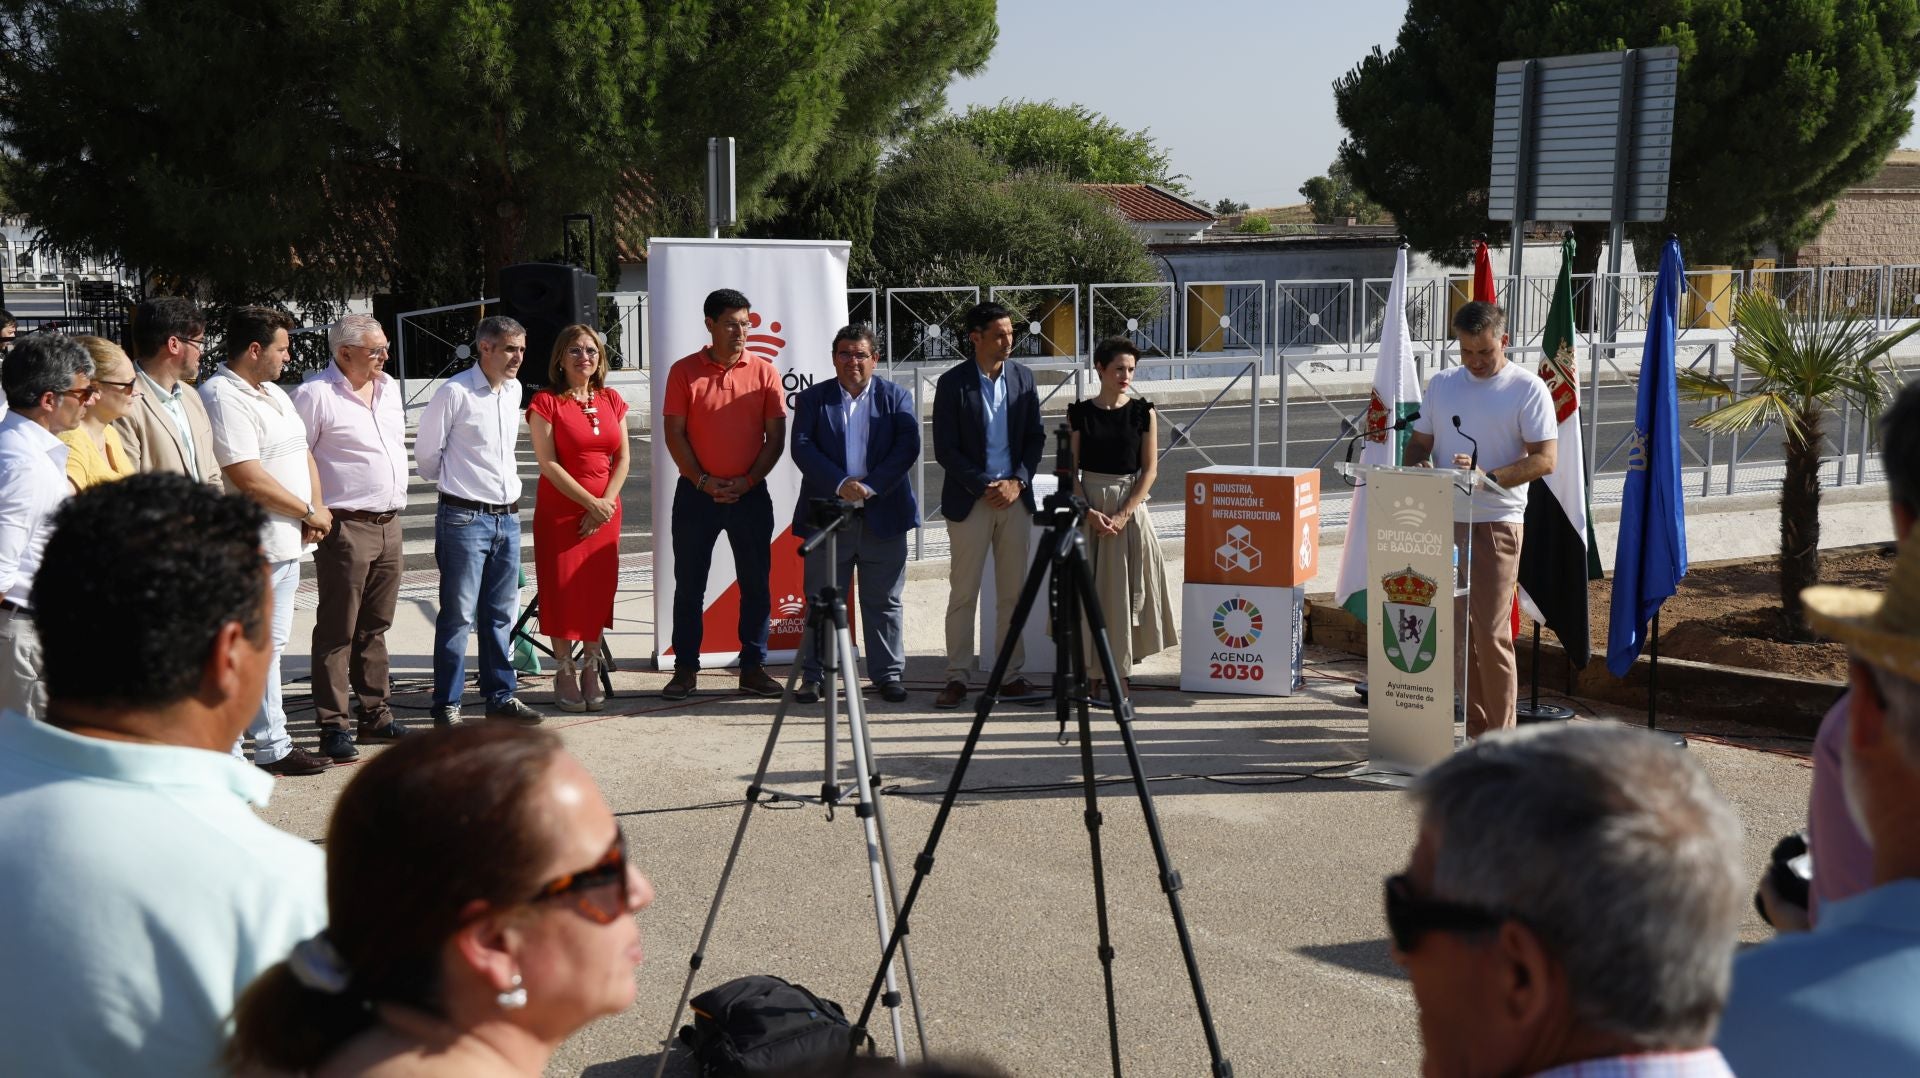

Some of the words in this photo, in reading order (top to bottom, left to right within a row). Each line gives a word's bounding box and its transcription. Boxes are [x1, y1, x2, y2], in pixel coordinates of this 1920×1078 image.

[1194, 482, 1206, 504] 9
[1213, 483, 1254, 495] INDUSTRIA,
[1212, 495, 1258, 507] INNOVACIÓN
[1259, 497, 1265, 507] E
[1212, 509, 1281, 521] INFRAESTRUCTURA
[1377, 529, 1443, 545] DIPUTACIÓN
[1377, 542, 1388, 551] DE
[1390, 541, 1443, 556] BADAJOZ
[778, 625, 804, 634] BADAJ
[1210, 652, 1264, 664] AGENDA
[1210, 663, 1264, 681] 2030
[1387, 681, 1434, 693] Ayuntamiento
[1395, 691, 1424, 701] Valverde
[1425, 694, 1434, 702] de
[1395, 699, 1424, 710] Leganés
